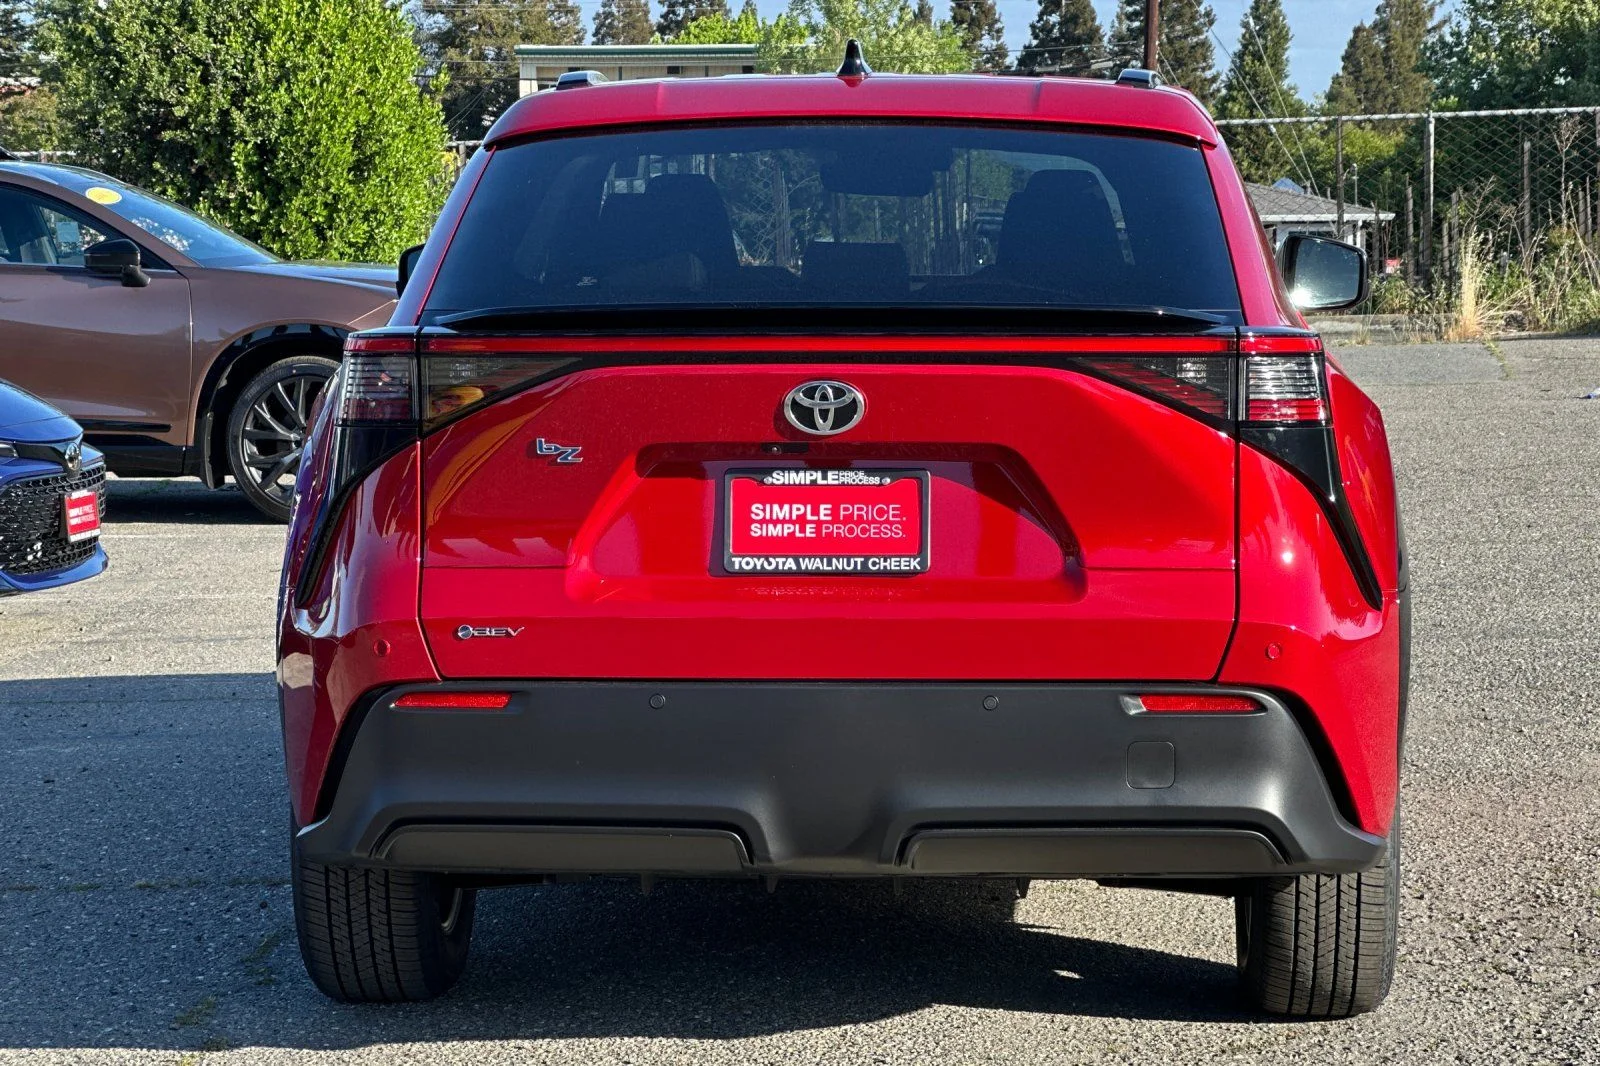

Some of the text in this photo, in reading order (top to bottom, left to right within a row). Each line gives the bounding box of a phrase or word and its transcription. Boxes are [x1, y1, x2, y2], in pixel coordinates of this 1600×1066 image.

[772, 470, 839, 485] SIMPLE
[750, 503, 907, 521] SIMPLE PRICE.
[750, 524, 906, 538] SIMPLE PROCESS.
[732, 557, 921, 570] TOYOTA WALNUT CHEEK
